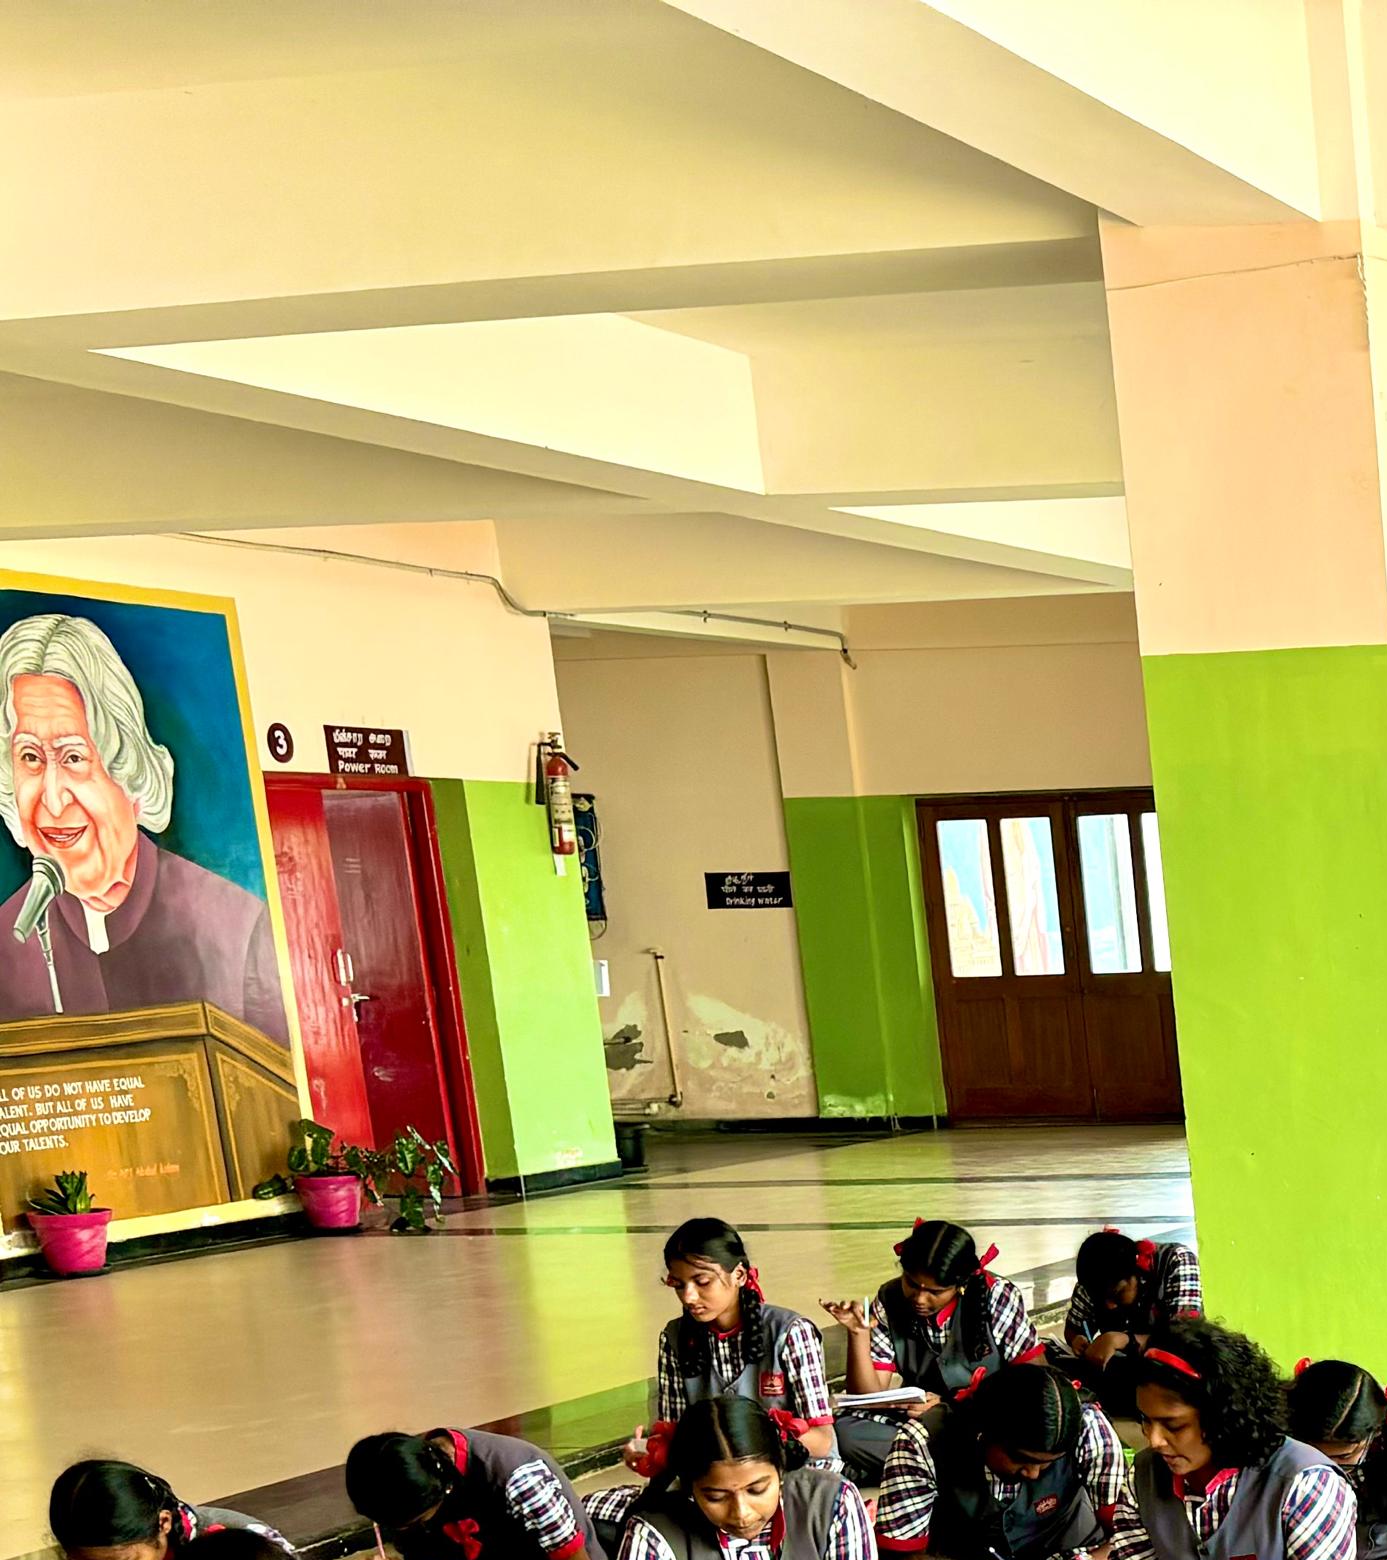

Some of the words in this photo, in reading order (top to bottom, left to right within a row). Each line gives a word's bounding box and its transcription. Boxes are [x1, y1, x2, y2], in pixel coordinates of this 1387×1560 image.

[274, 730, 288, 755] 3
[338, 760, 371, 772] Power
[12, 1088, 25, 1100] OF
[28, 1086, 42, 1098] US
[44, 1084, 60, 1097] DO
[63, 1082, 83, 1095] NOT
[85, 1080, 111, 1093] HAVE
[113, 1076, 145, 1091] EQUAL
[35, 1102, 54, 1115] BUT
[57, 1100, 73, 1113] ALL
[75, 1099, 87, 1111] OF
[91, 1097, 104, 1109] US
[110, 1094, 135, 1108] HAVE
[30, 1114, 96, 1132] OPPORTUNITY
[98, 1113, 111, 1125] TO
[111, 1109, 151, 1123] DEVELOP
